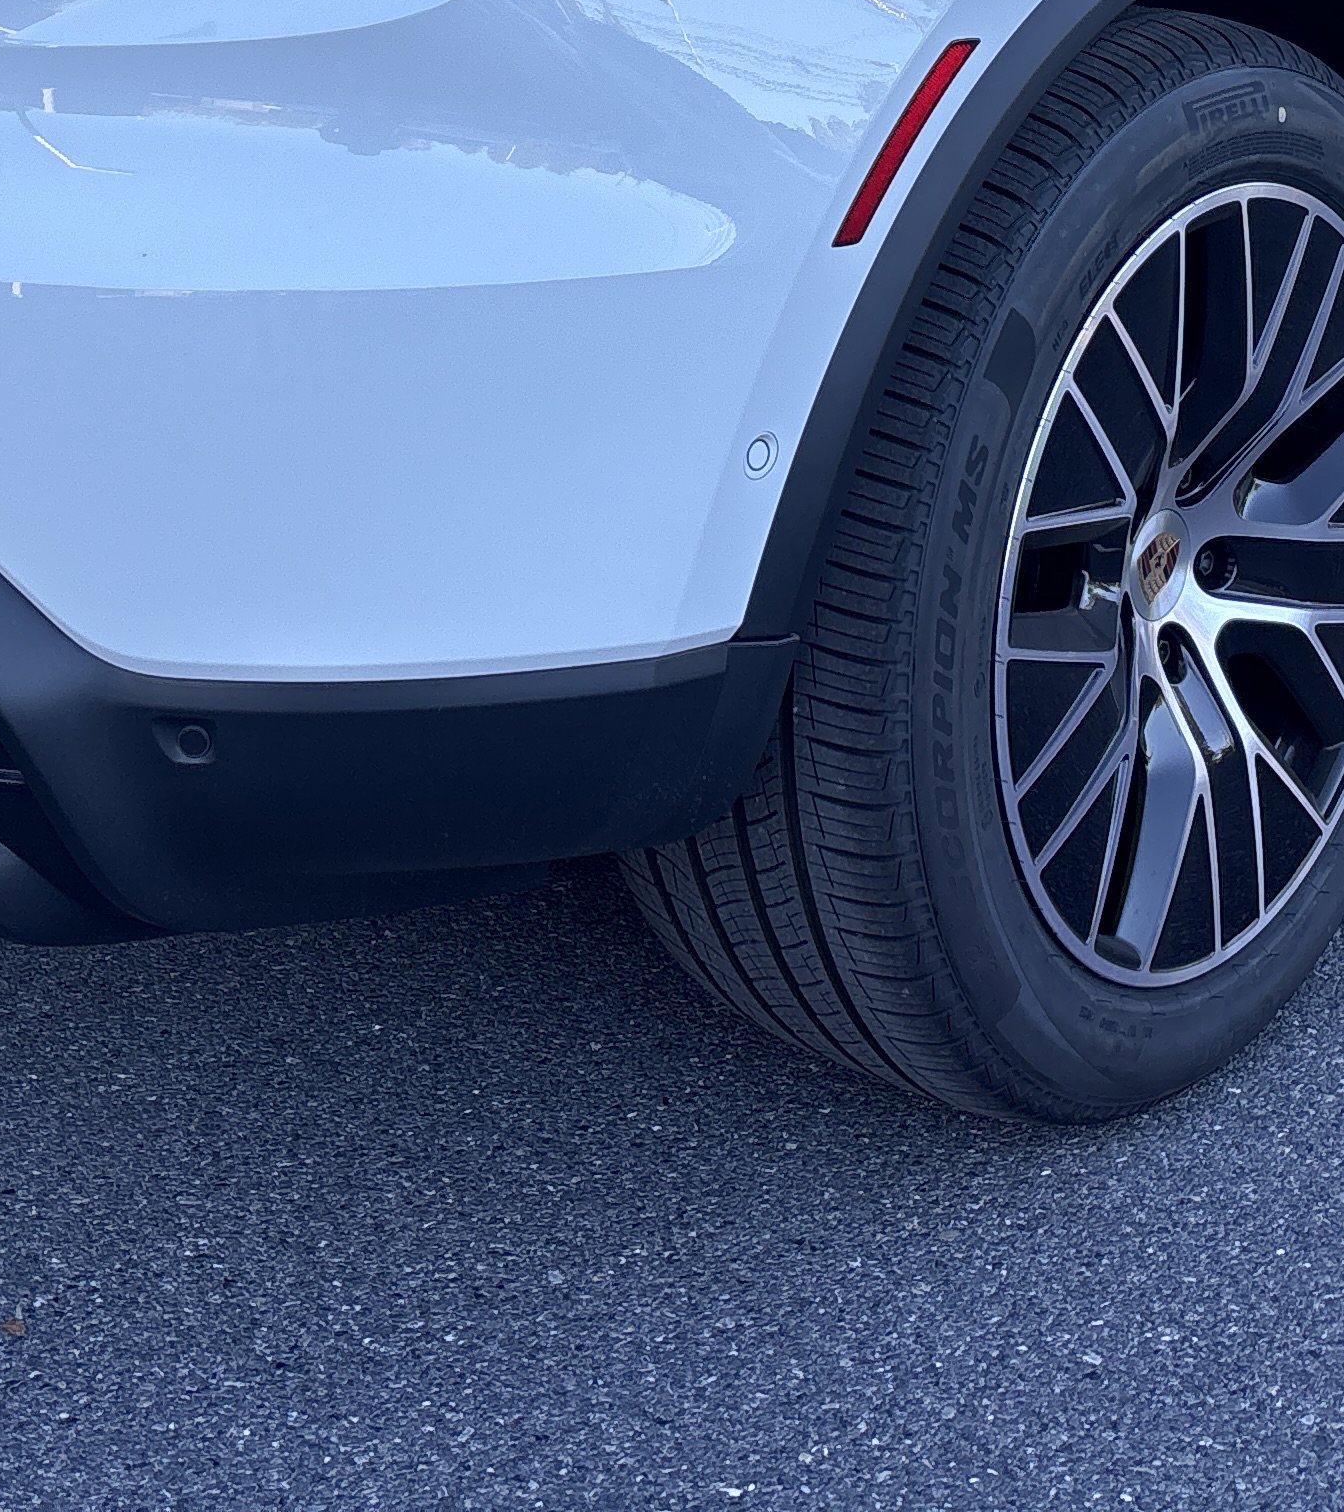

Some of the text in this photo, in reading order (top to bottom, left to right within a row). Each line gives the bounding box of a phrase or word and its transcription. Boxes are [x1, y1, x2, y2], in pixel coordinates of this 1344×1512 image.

[1182, 79, 1271, 136] PIRELLI
[932, 434, 990, 904] SCORPION MS
